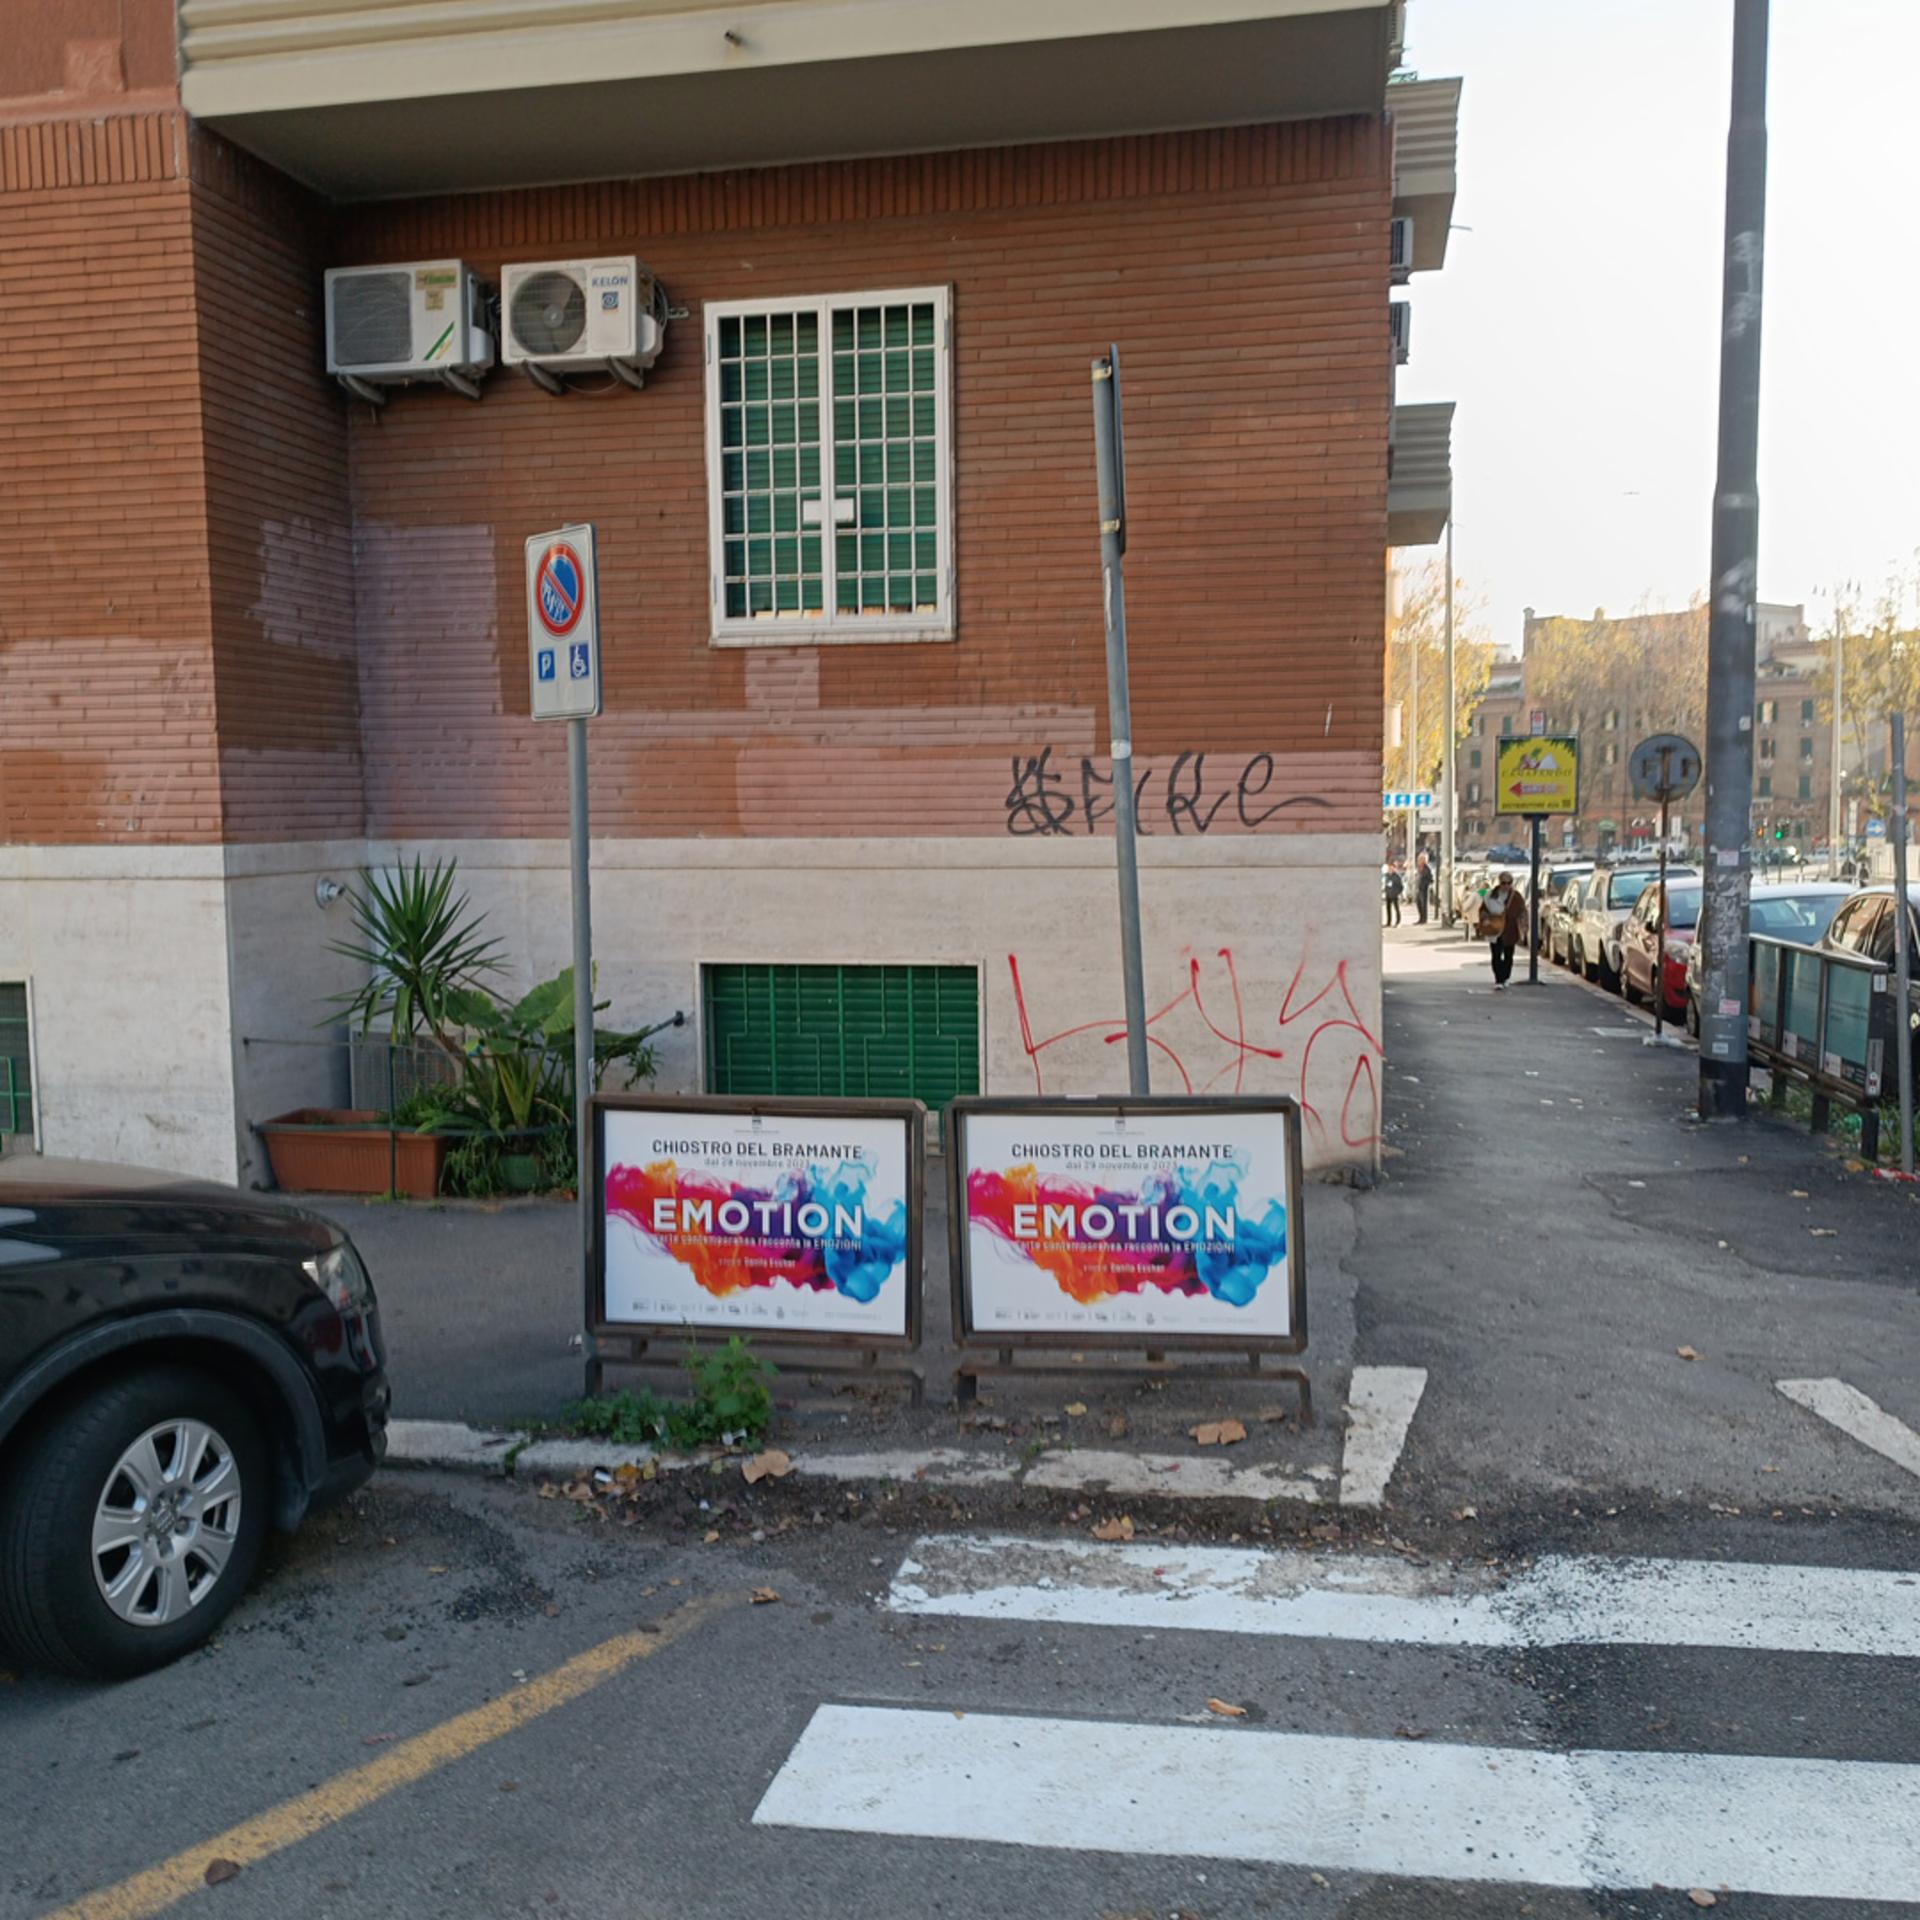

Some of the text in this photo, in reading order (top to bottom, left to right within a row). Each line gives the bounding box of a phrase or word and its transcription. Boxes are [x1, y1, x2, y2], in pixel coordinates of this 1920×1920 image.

[591, 275, 628, 287] KELON
[541, 653, 552, 678] P
[652, 1139, 863, 1159] CHIOSTRO DEL BRAMANTE
[1011, 1143, 1233, 1159] CHIOSTRO DEL BRAMANTE
[736, 1158, 783, 1169] novembre
[1098, 1161, 1149, 1170] novembre
[653, 1198, 863, 1238] EMOTION
[1012, 1205, 1235, 1240] EMOTION
